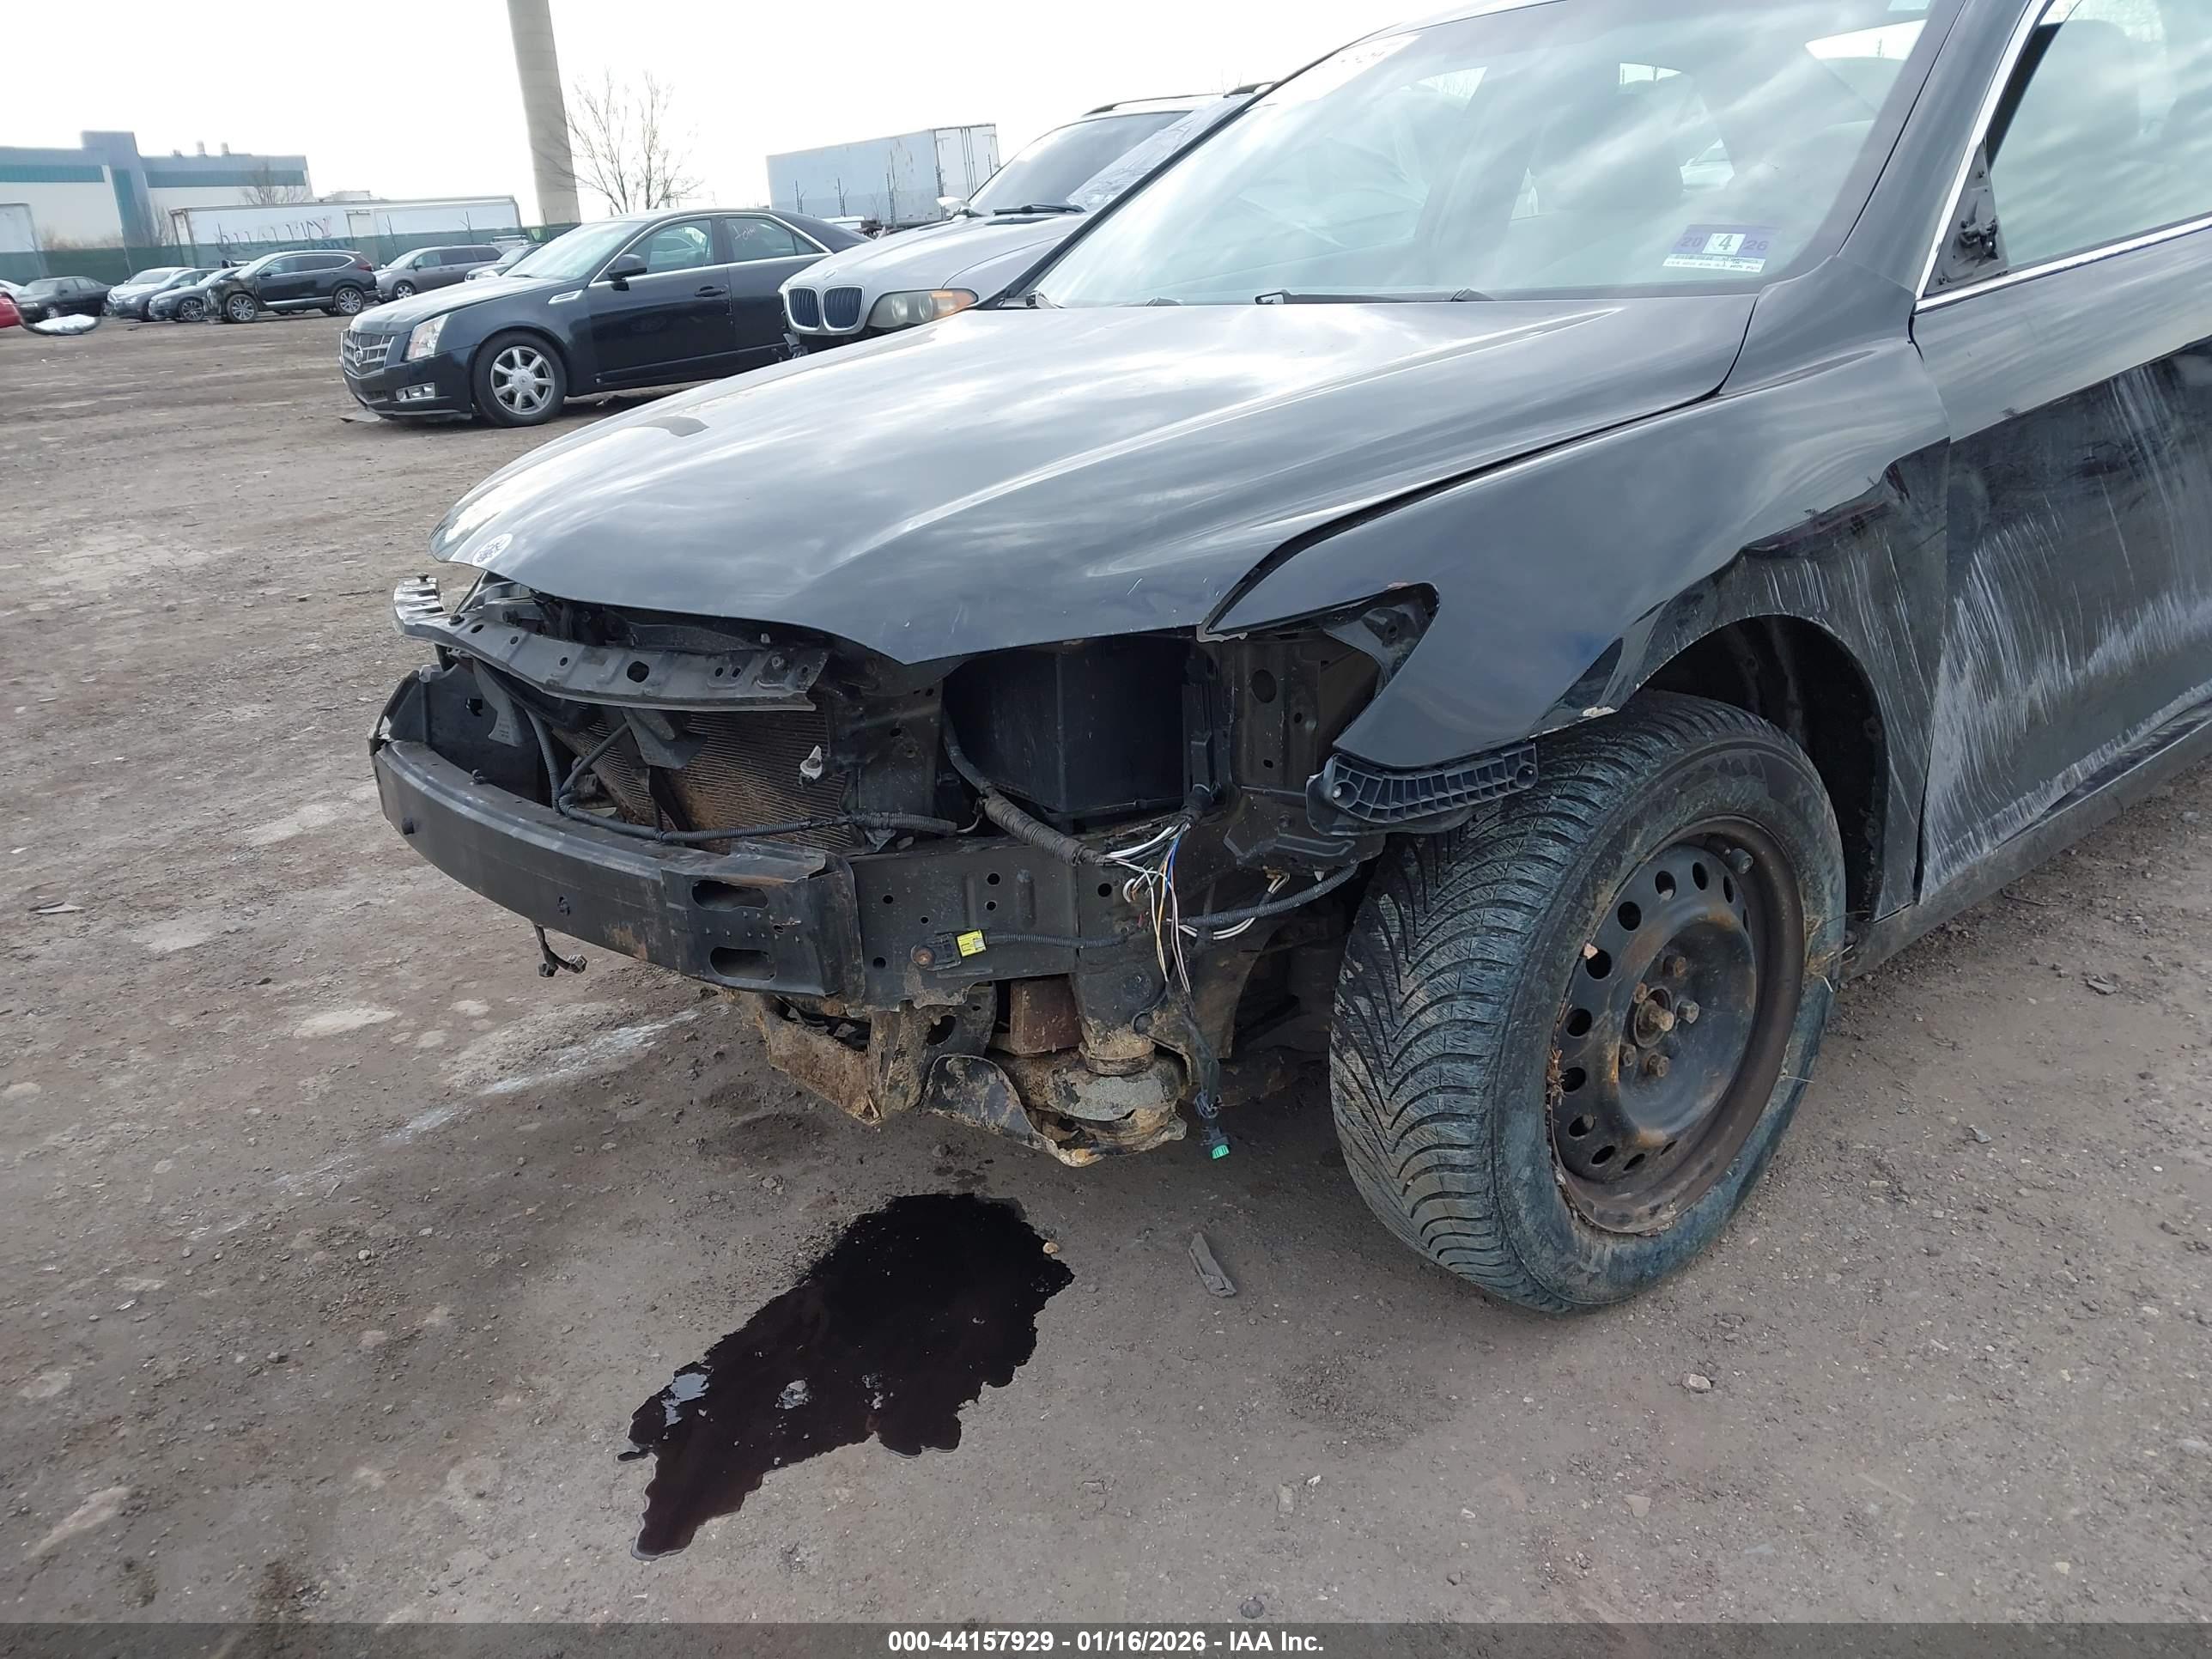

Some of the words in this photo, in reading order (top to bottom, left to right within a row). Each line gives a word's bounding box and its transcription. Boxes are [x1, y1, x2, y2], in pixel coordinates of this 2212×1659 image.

[1680, 236, 1704, 248] 20
[1717, 234, 1734, 251] 4
[1743, 240, 1770, 251] 26
